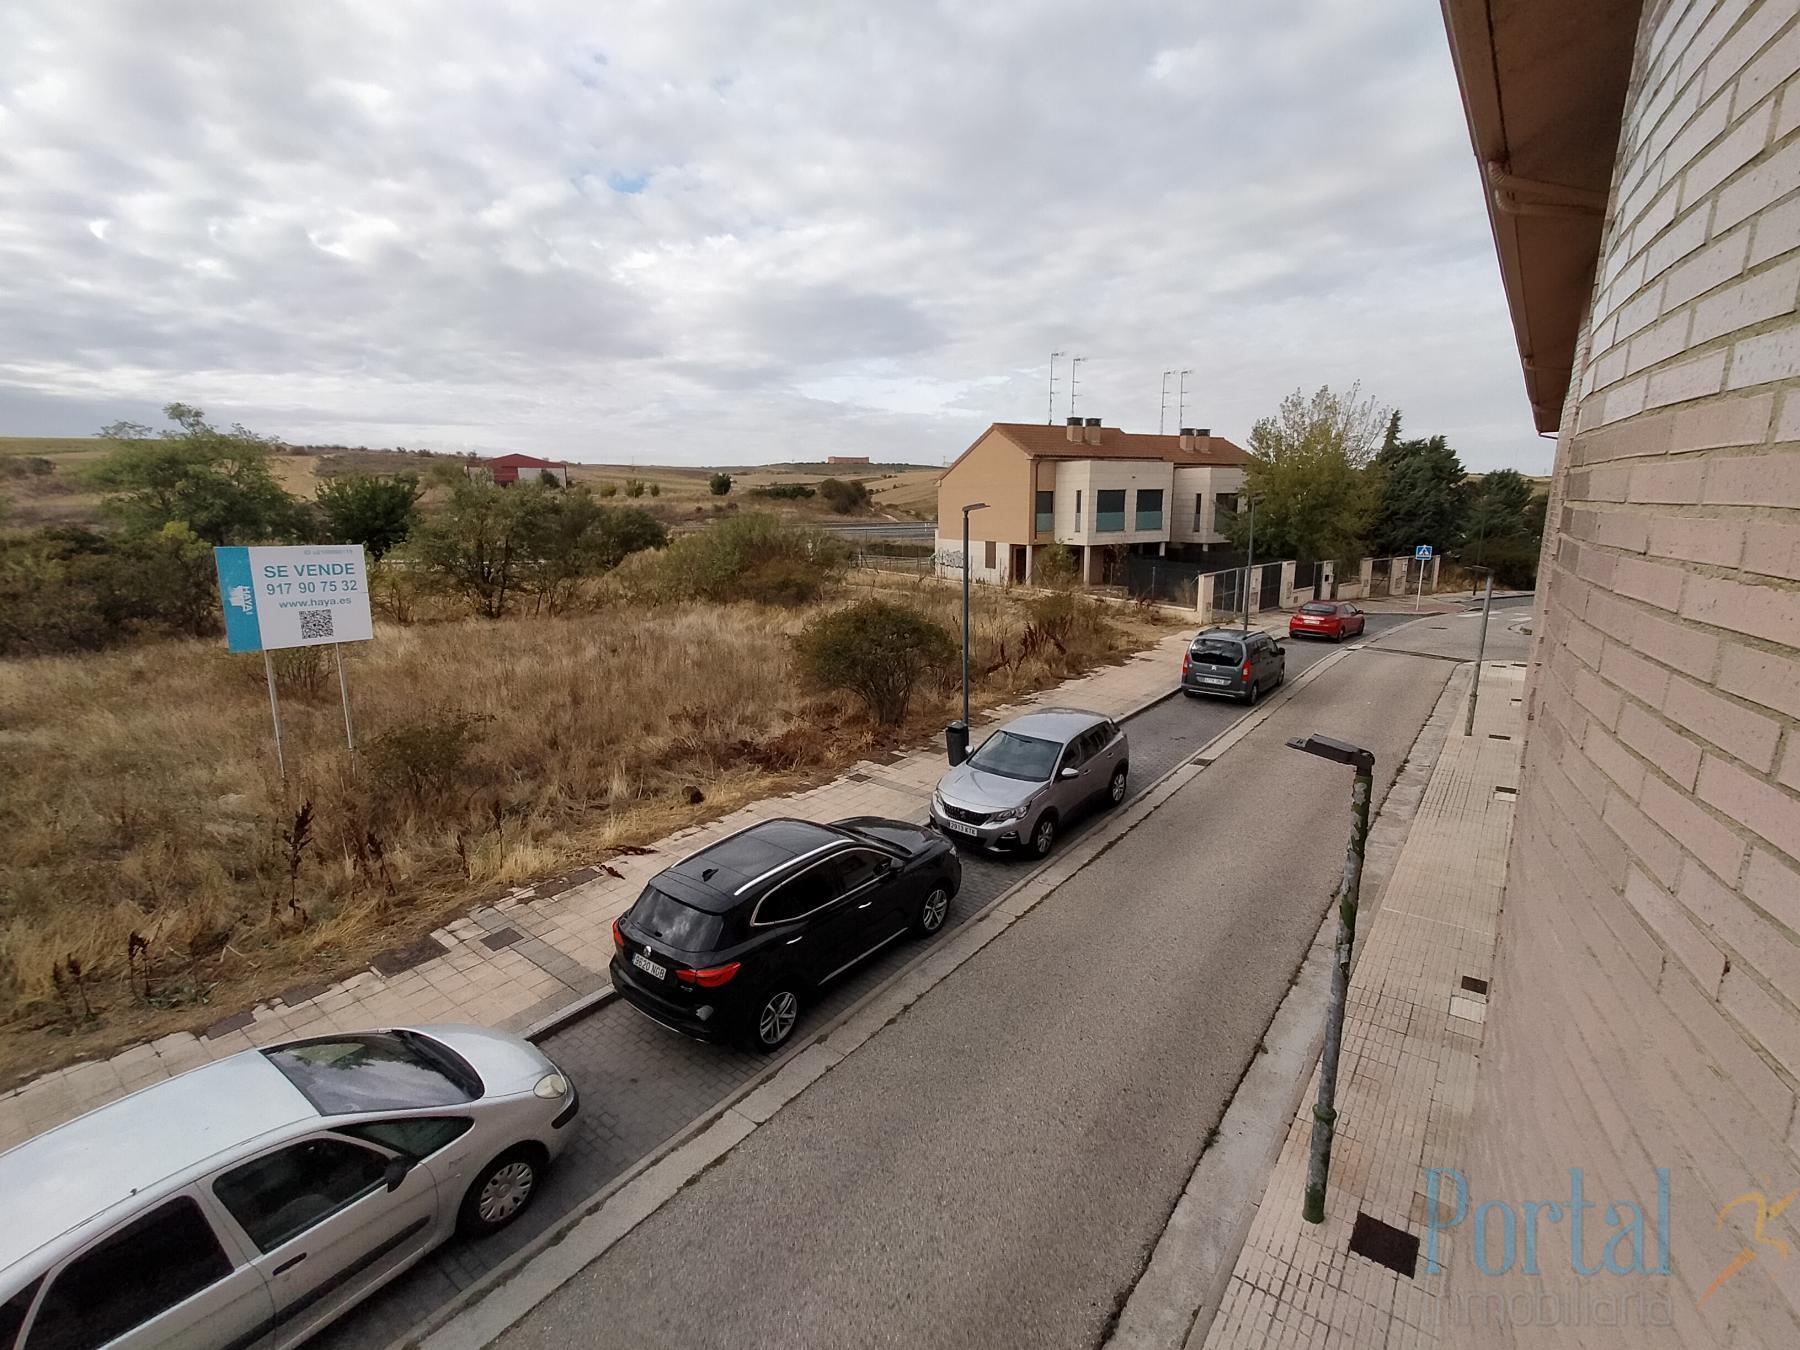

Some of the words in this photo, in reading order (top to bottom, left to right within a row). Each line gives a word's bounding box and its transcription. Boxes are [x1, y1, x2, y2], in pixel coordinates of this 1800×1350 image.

[264, 565, 288, 578] SE
[294, 563, 355, 577] VENDE
[266, 583, 292, 595] 917
[299, 581, 316, 593] 90
[320, 580, 337, 592] 75
[342, 580, 358, 591] 32
[279, 597, 352, 608] www.haya.es
[651, 964, 665, 978] NGB
